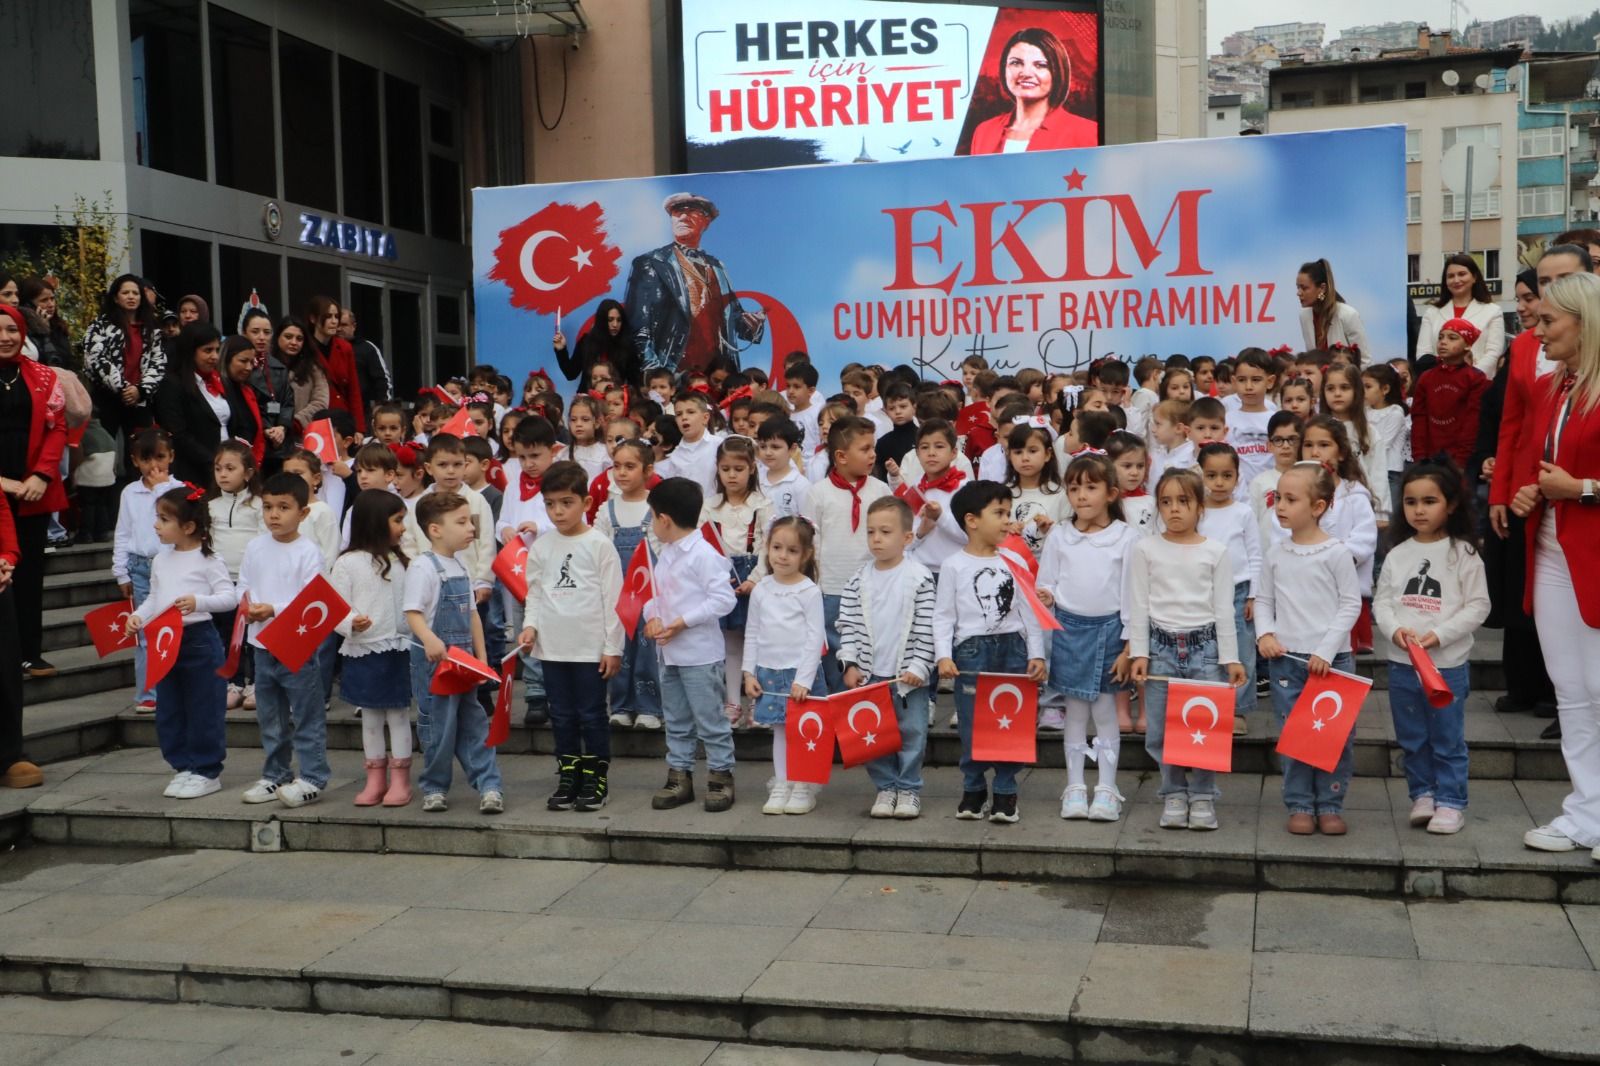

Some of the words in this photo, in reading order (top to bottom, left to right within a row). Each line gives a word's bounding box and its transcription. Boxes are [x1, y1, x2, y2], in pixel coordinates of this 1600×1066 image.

[735, 17, 938, 62] HERKES
[808, 57, 877, 83] için
[708, 76, 962, 134] HÜRRİYET
[299, 212, 398, 261] ZABITA
[1060, 282, 1276, 331] BAYRAMIMIZ
